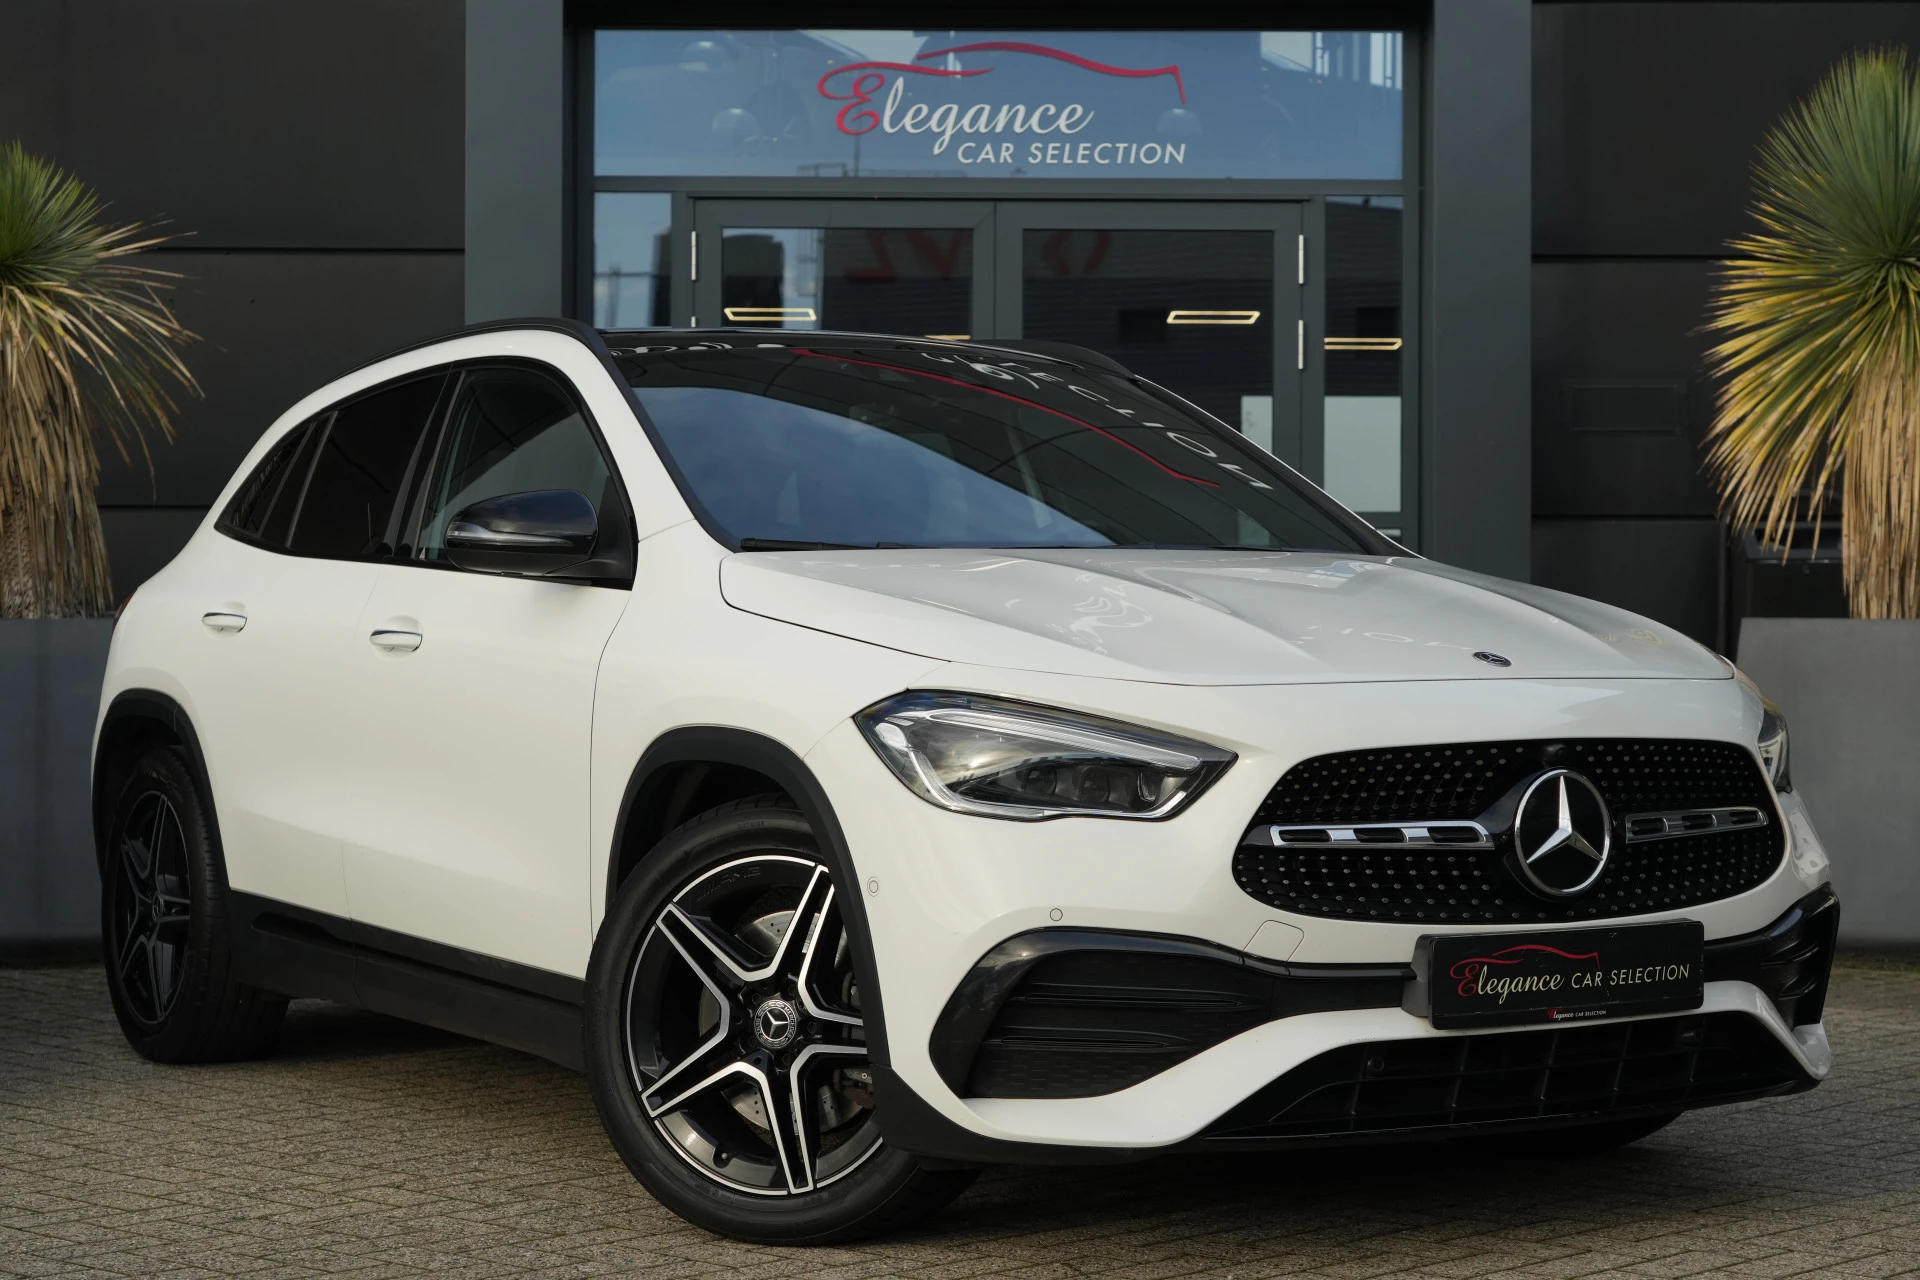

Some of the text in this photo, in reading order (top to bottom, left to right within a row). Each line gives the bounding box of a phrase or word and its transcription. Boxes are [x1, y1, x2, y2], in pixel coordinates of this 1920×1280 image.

[818, 63, 1094, 156] Elegance
[957, 142, 1187, 165] CAR SELECTION
[1450, 958, 1690, 1004] Elegance CAR SELECTION
